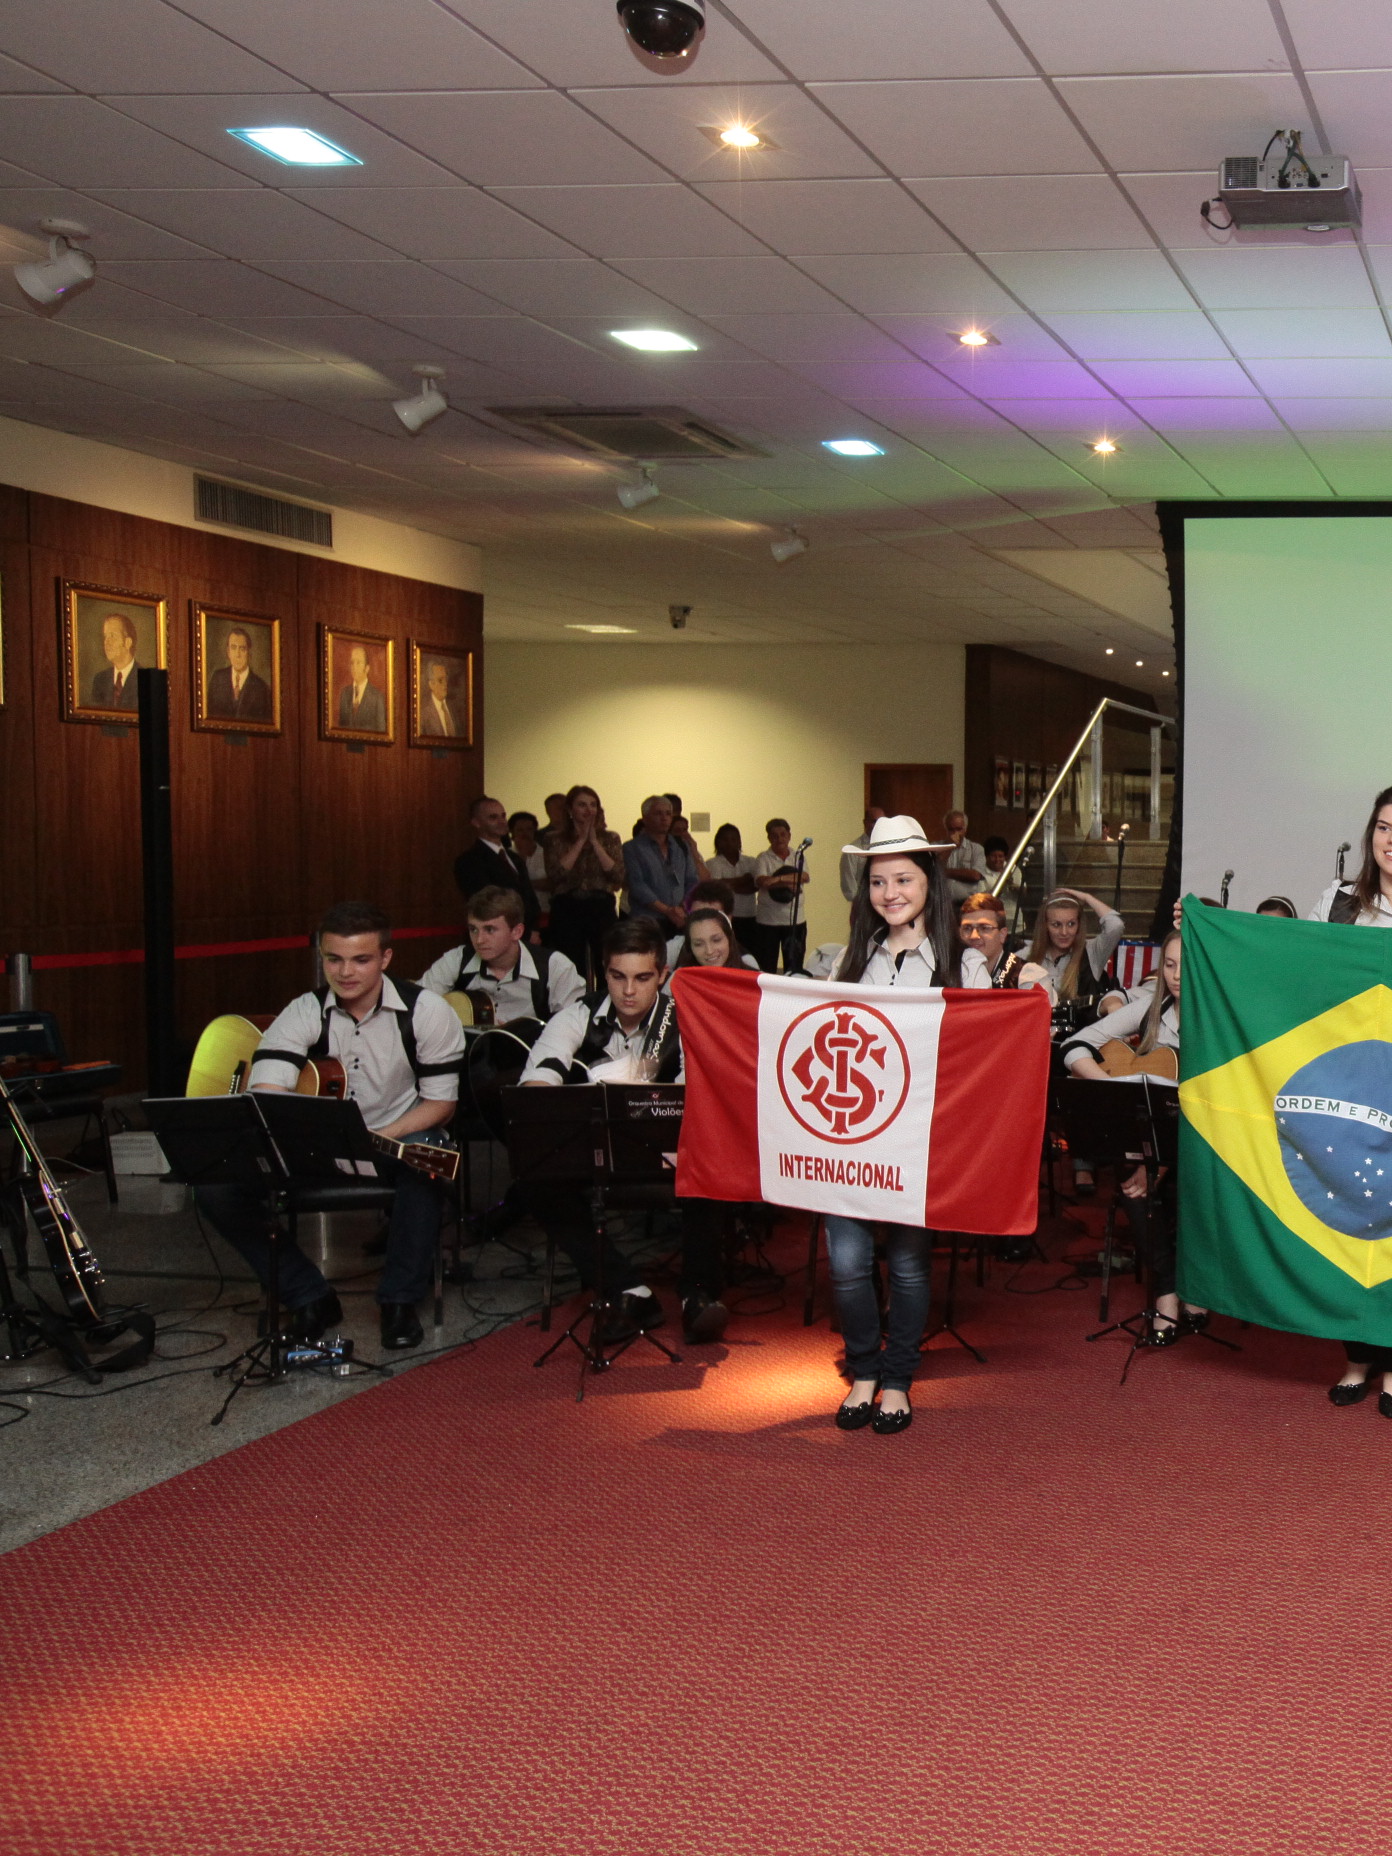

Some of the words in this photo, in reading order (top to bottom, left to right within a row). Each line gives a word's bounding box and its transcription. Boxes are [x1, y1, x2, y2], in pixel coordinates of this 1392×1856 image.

[1275, 1097, 1341, 1113] ORDEM
[1349, 1106, 1359, 1116] E
[779, 1152, 904, 1192] INTERNACIONAL
